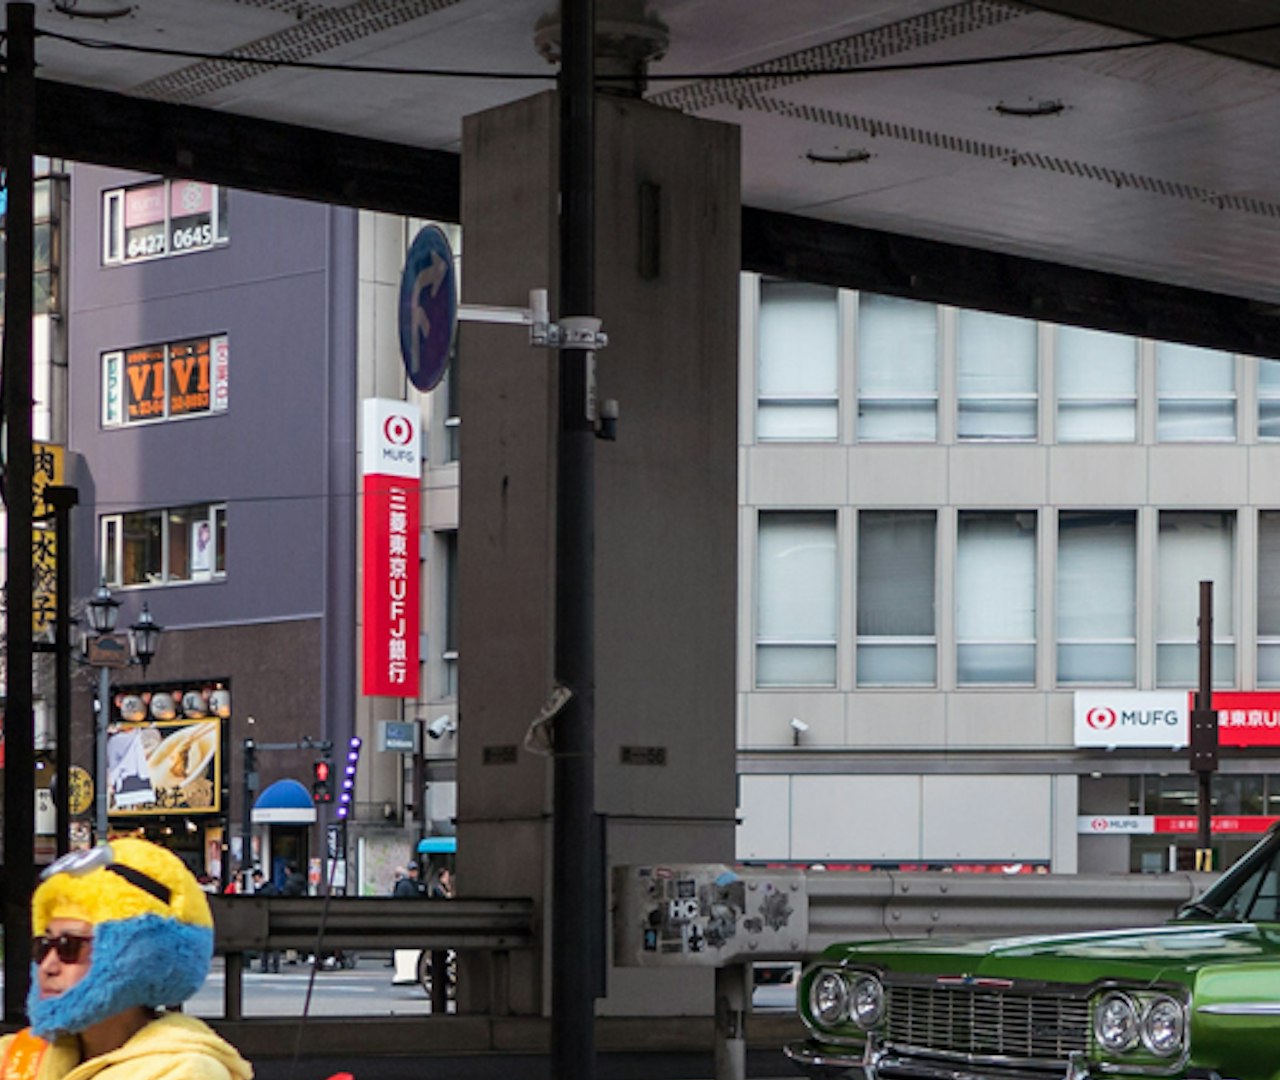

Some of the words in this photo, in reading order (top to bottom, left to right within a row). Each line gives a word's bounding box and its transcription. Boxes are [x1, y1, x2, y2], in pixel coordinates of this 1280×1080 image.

[128, 233, 164, 257] 6427
[173, 225, 211, 248] 0645
[383, 448, 414, 462] MUFG
[1121, 711, 1178, 726] MUFG
